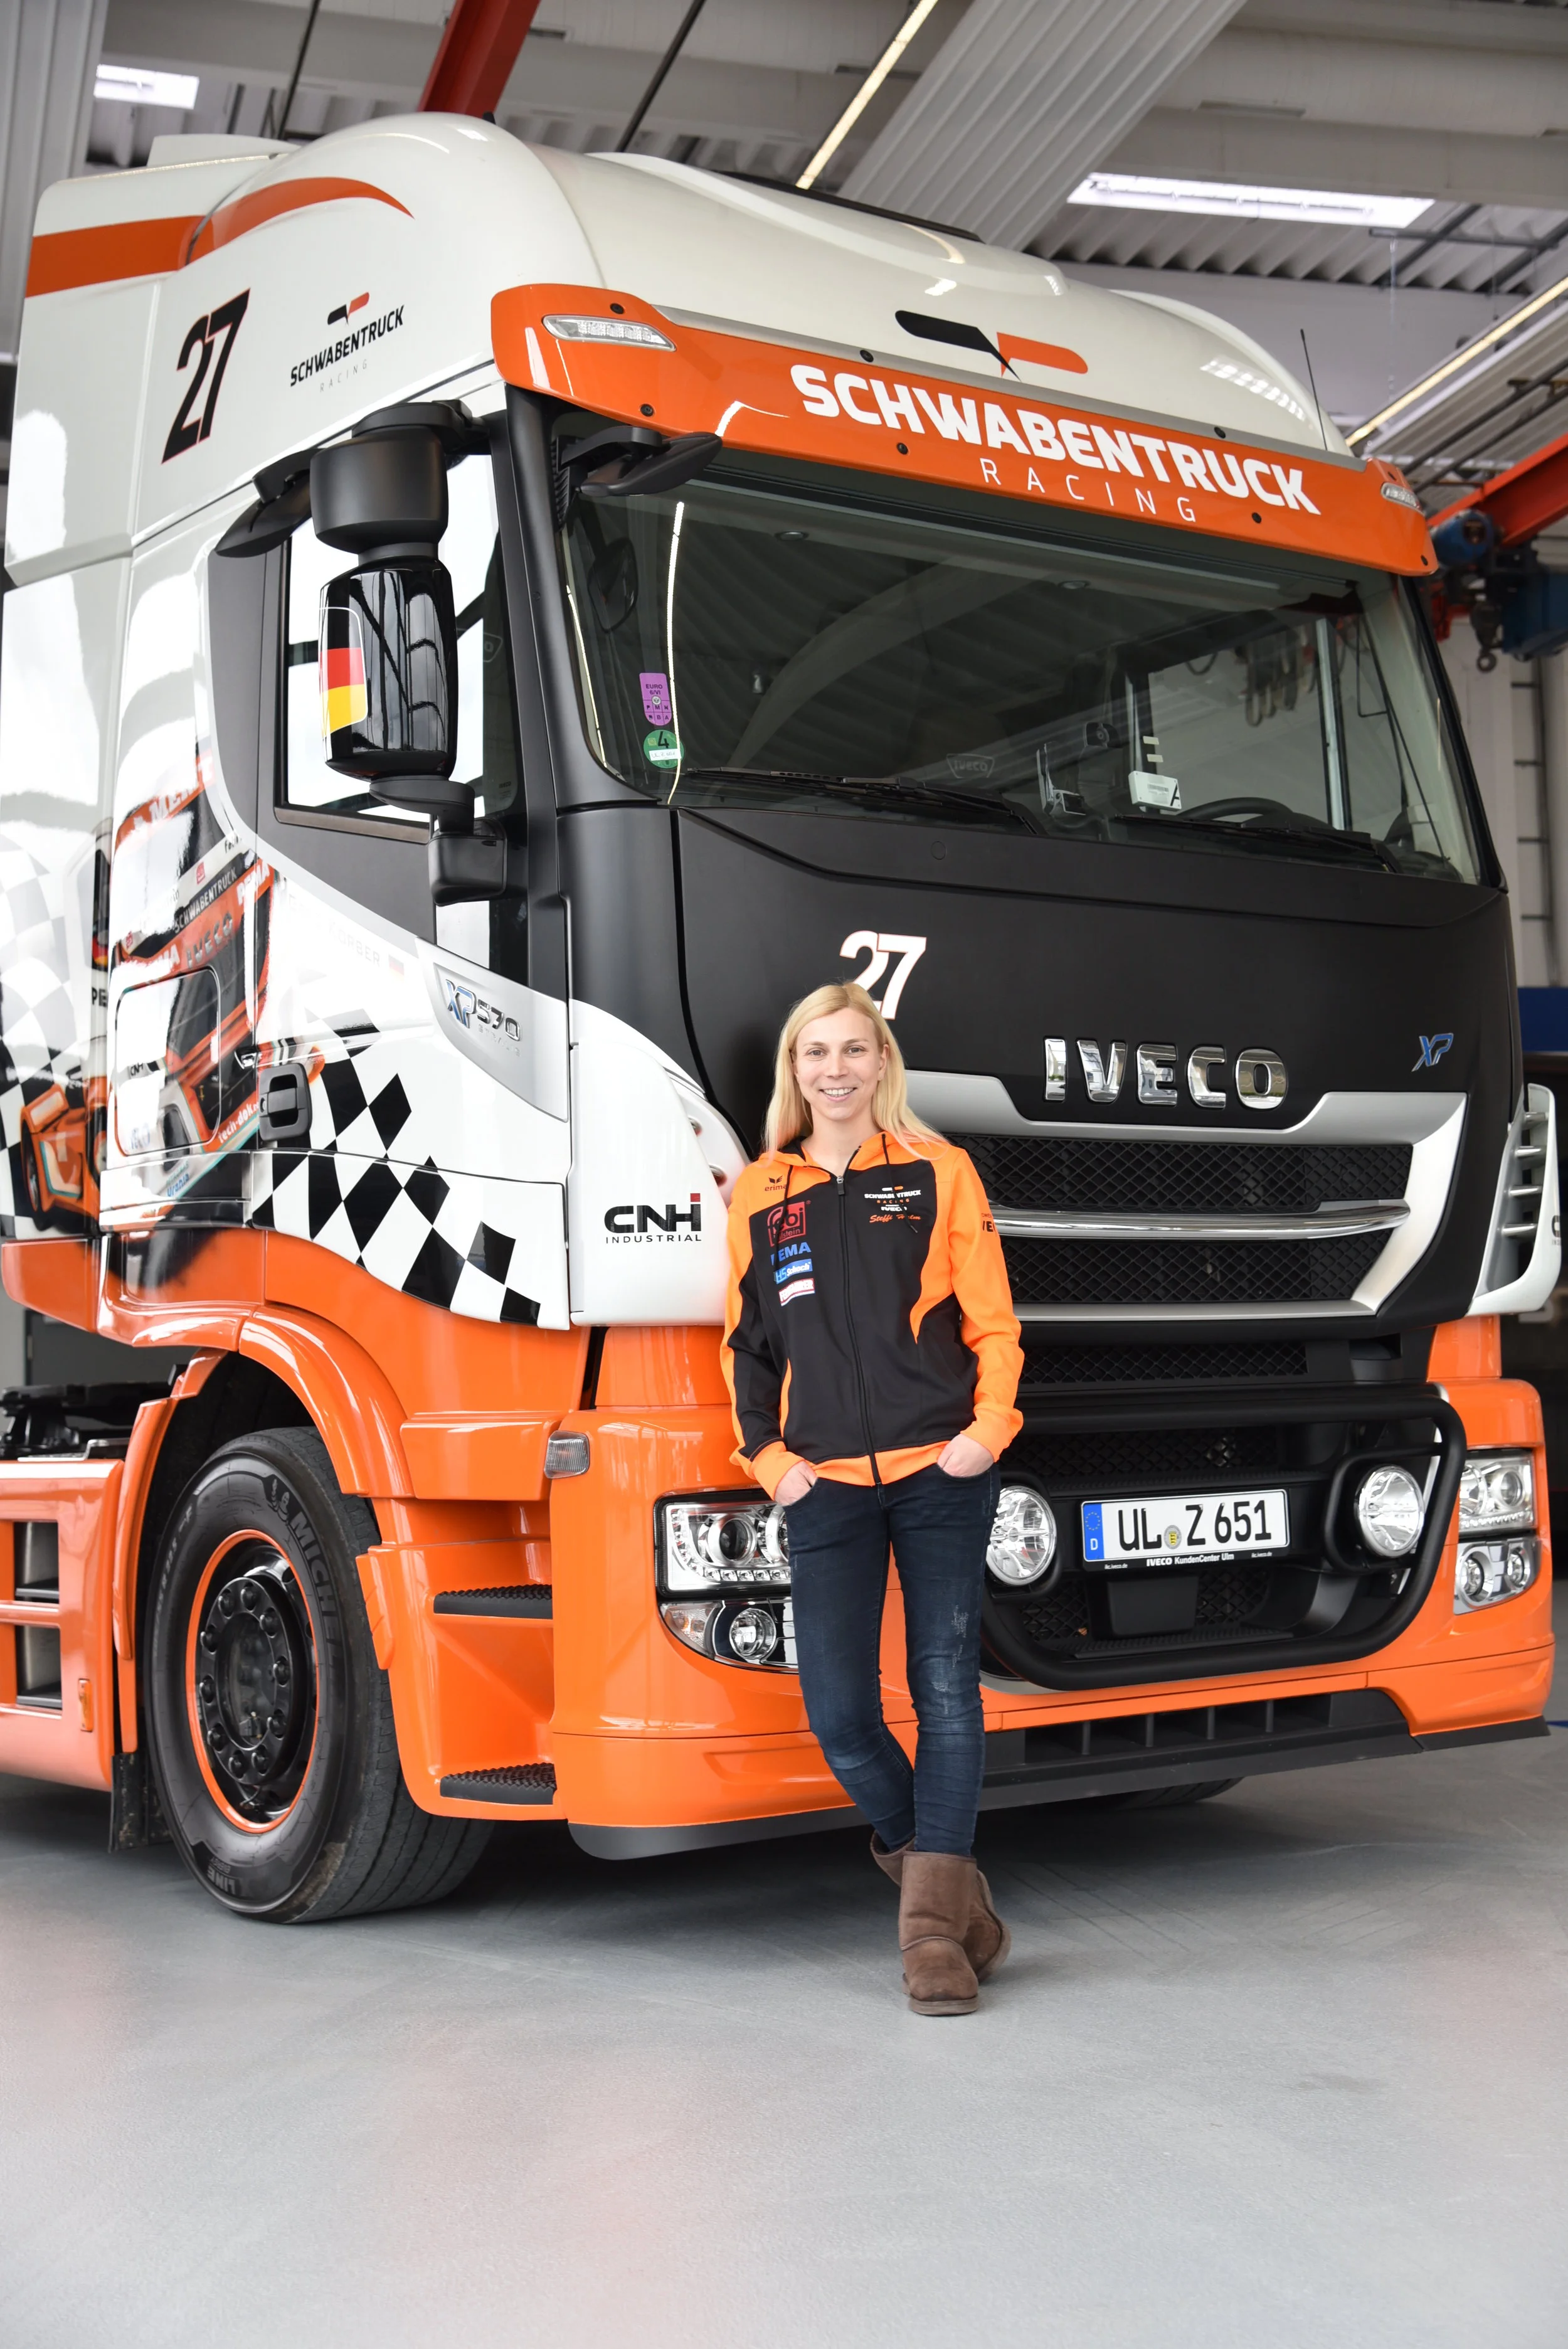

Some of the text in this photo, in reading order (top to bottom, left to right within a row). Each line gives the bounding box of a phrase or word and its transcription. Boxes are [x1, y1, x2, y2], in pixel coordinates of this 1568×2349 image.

[289, 305, 405, 387] SCHWABENTRUCK
[161, 288, 251, 465] 27
[320, 360, 368, 393] RACING
[790, 364, 1322, 516] SCHWABENTRUCK
[979, 457, 1197, 522] RACING
[657, 731, 669, 749] 4
[175, 869, 237, 933] SCHWABENTRUCK
[186, 911, 233, 969] IVECO
[839, 930, 927, 1020] 27
[1044, 1037, 1287, 1110] IVECO
[1411, 1032, 1454, 1072] XP
[765, 1184, 788, 1192] erima
[606, 1234, 702, 1244] INDUSTRIAL
[1090, 1538, 1098, 1551] D
[1118, 1500, 1271, 1551] UL Z 651
[1147, 1552, 1234, 1567] IVECO KundenCenter Ulm
[289, 1510, 343, 1687] MICHEL
[207, 1865, 236, 1894] LINE
